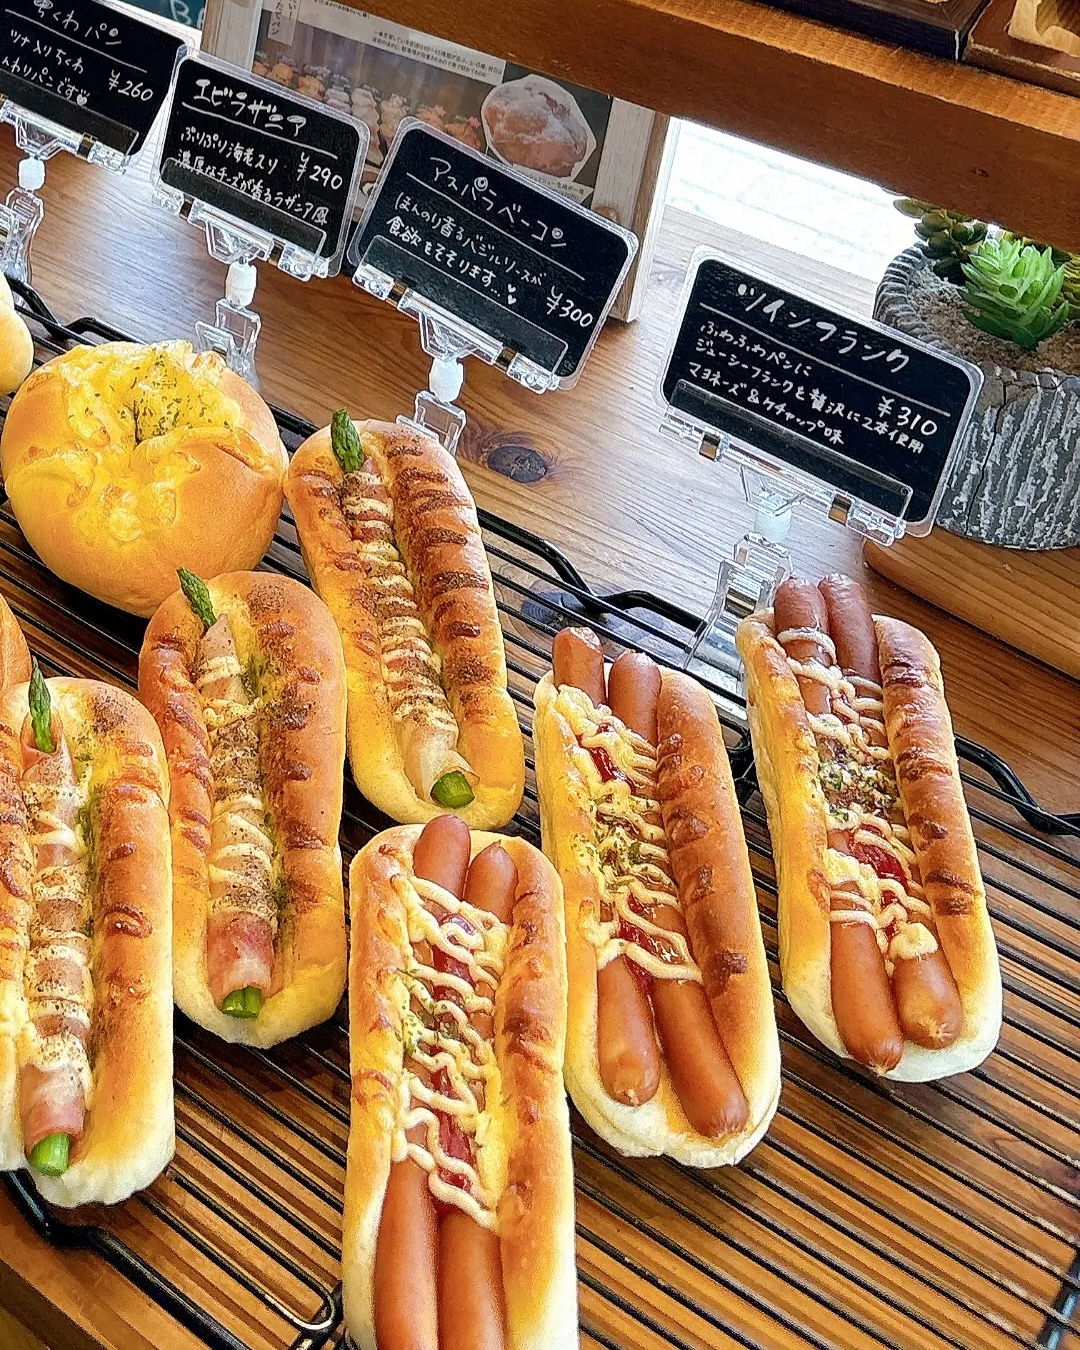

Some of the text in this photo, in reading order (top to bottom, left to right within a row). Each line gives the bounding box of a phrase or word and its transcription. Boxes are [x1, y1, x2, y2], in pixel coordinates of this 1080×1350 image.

[10, 28, 84, 75] ツナ入りちくわ
[108, 68, 154, 102] ¥260
[193, 78, 307, 138] エビラザニア
[175, 148, 330, 226] 濃厚なチーズが香るラザニア風
[180, 125, 344, 191] ぷりぷり海老入り ¥290
[394, 191, 548, 286] ほんのり香るバジルソースが
[429, 156, 568, 249] アスパラベーコン
[545, 285, 594, 329] ¥300
[736, 282, 910, 374] ツインフランク
[699, 321, 813, 379] ふわふわパンに
[688, 360, 846, 447] マヨネーズ&ケチャップ味
[695, 337, 939, 456] ジューシーフランクを贅沢に2本使用 ¥310
